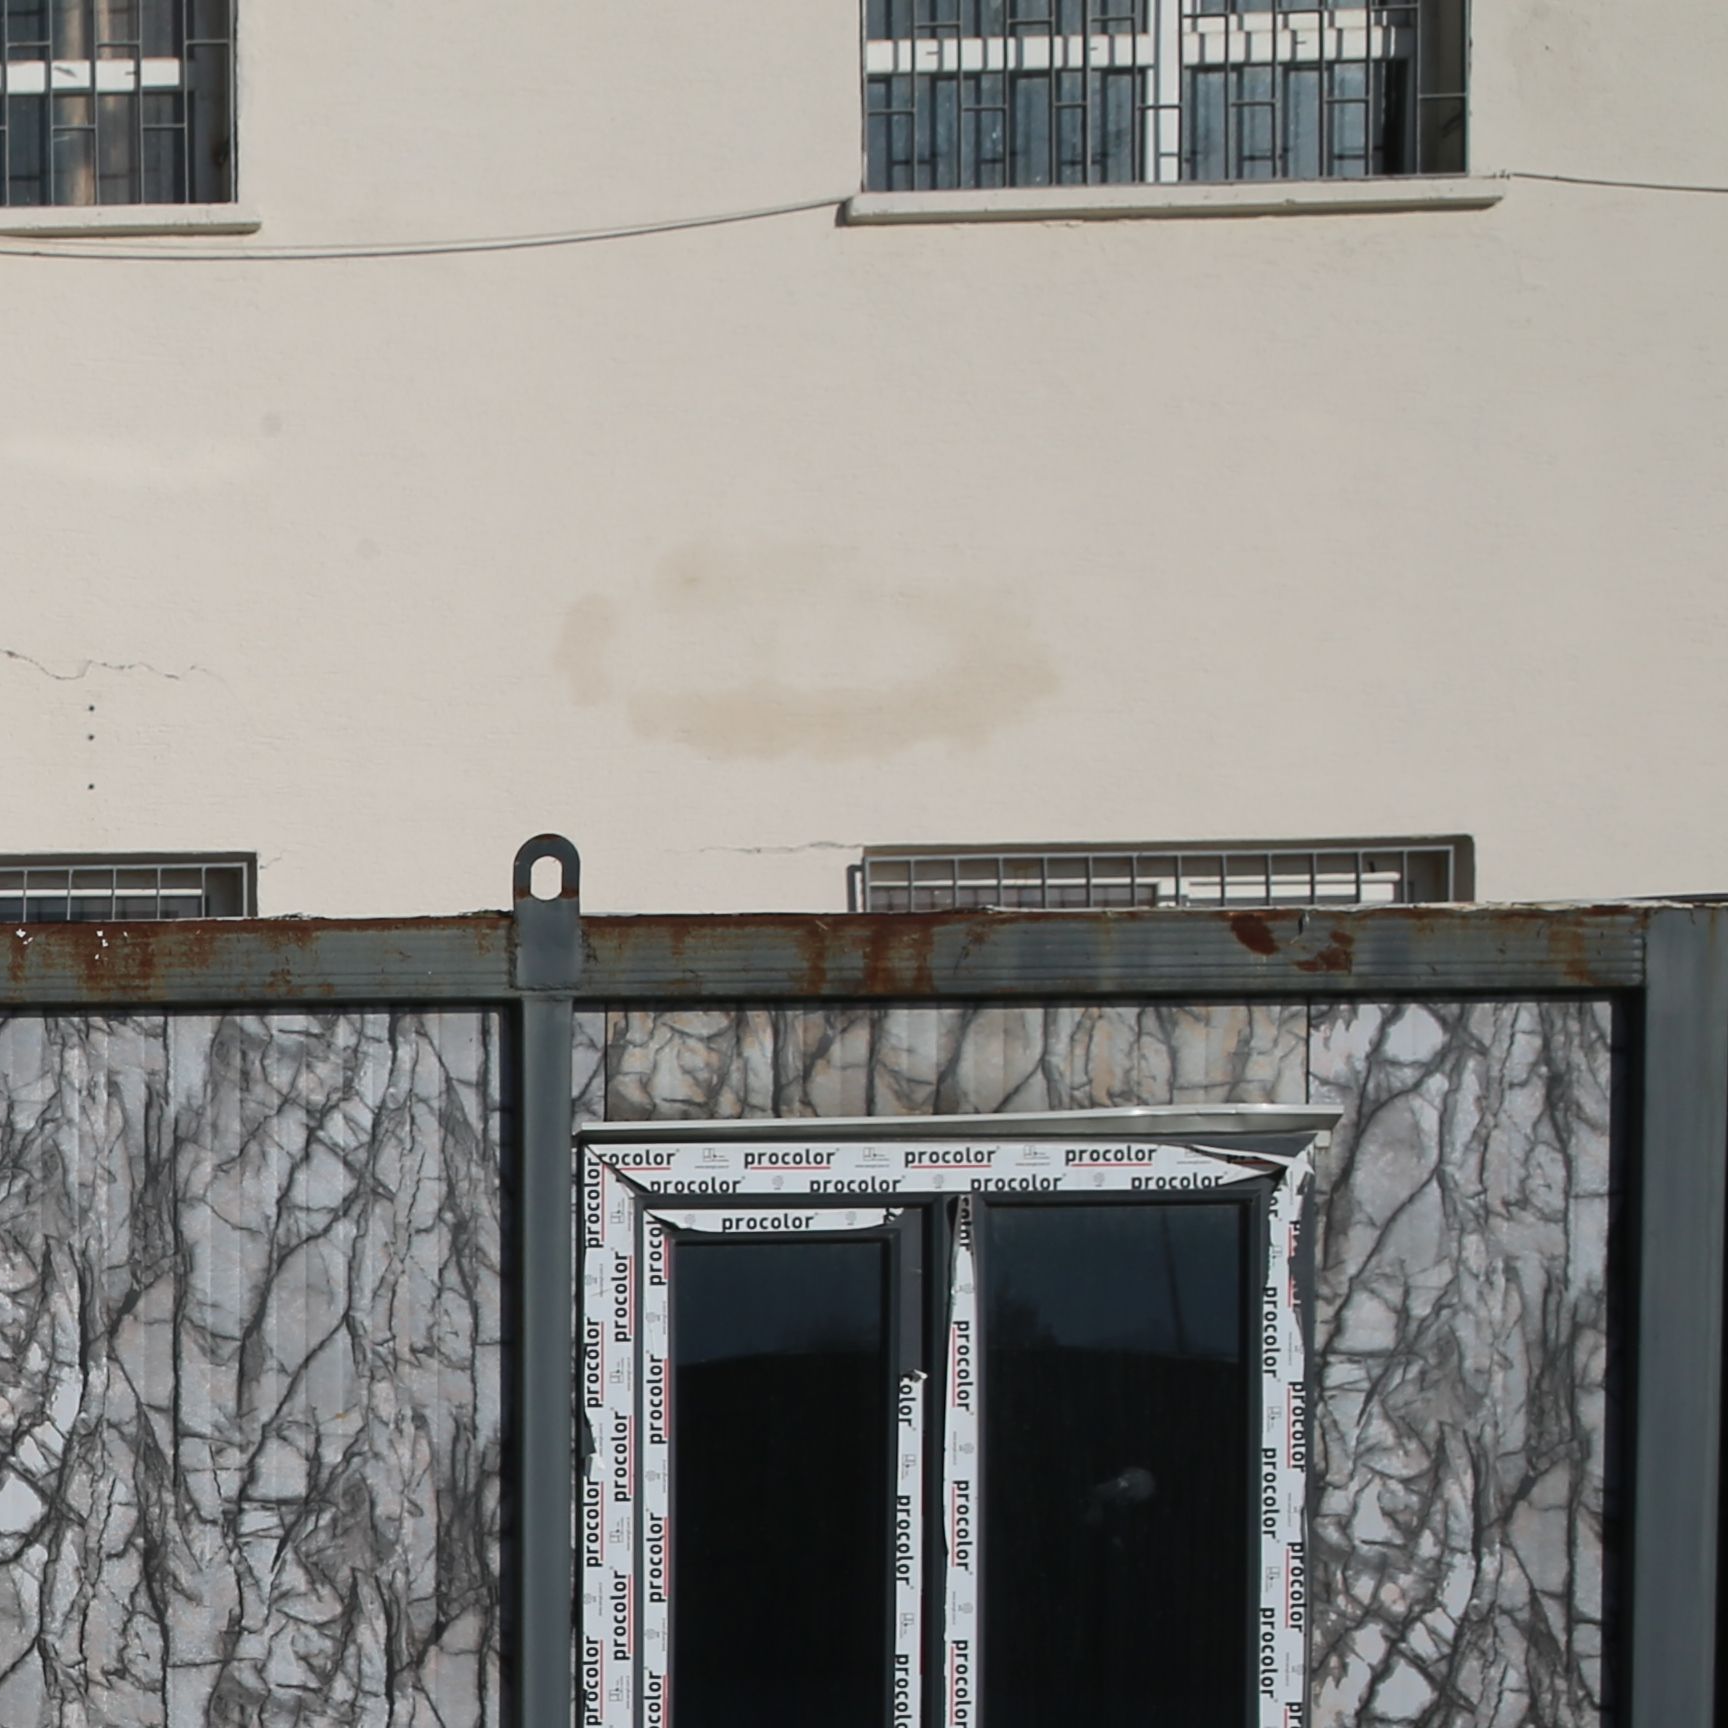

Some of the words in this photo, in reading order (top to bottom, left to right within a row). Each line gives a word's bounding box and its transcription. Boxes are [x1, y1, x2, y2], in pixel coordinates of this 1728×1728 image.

[585, 1157, 603, 1248] procolor
[600, 1149, 675, 1166] rocolor
[744, 1148, 835, 1169] procolor
[904, 1147, 996, 1168] procolor
[1065, 1145, 1157, 1166] procolor
[650, 1177, 741, 1194] procolor
[810, 1176, 901, 1193] procolor
[971, 1173, 1062, 1192] procolor
[1131, 1172, 1224, 1190] procolor
[722, 1213, 814, 1232] procolor
[611, 1251, 631, 1343] procolor
[1264, 1286, 1281, 1379] procolor
[585, 1317, 603, 1408] procolor
[646, 1353, 667, 1445] procolor
[952, 1320, 973, 1412] procolor
[611, 1410, 631, 1502] procolor
[1262, 1447, 1279, 1540] procolor
[584, 1477, 602, 1567] procolor
[646, 1512, 666, 1603] procolor
[896, 1495, 914, 1586] procolor
[952, 1480, 973, 1572] procolor
[610, 1570, 630, 1661] procolor
[1288, 1541, 1307, 1633] procolor
[584, 1635, 602, 1726] procolor
[1260, 1607, 1278, 1700] procolor
